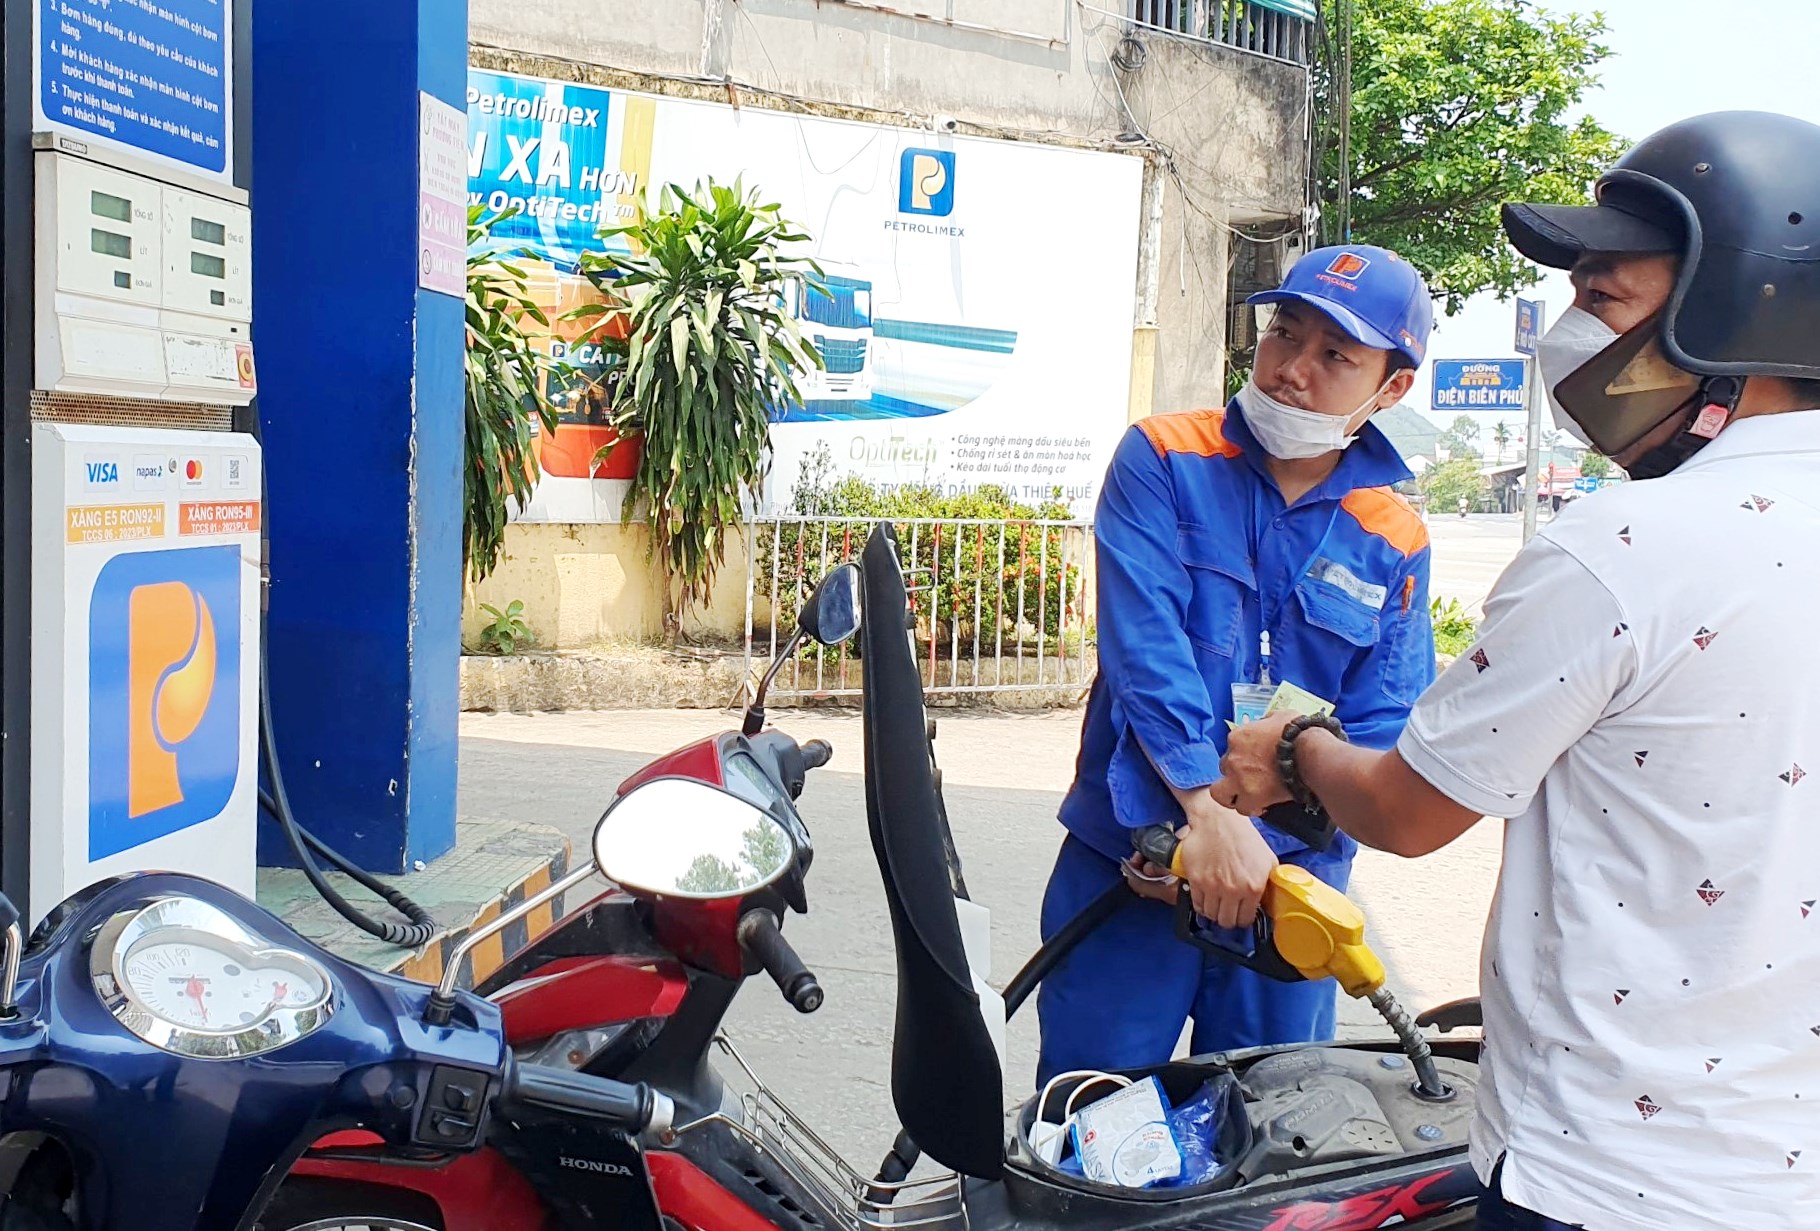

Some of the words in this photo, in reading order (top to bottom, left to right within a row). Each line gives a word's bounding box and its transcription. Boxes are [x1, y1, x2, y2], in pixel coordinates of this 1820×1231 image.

[61, 2, 81, 21] Bơm
[138, 35, 154, 52] theo
[50, 40, 58, 53] 4.
[79, 50, 103, 70] khách
[84, 69, 95, 84] khi
[97, 73, 116, 92] thanh
[51, 80, 58, 94] 5.
[101, 98, 122, 116] thanh
[498, 134, 571, 188] XA
[580, 166, 638, 196] HƠN
[488, 190, 606, 224] OptiTech
[884, 220, 965, 237] PETROLIMEX
[1462, 362, 1500, 374] ĐƯỜNG
[1438, 387, 1466, 406] ĐIỆN
[1468, 384, 1497, 405] BIÊN
[1500, 384, 1523, 404] PHỦ
[958, 434, 980, 446] Công
[983, 436, 1005, 447] nghệ
[1008, 437, 1033, 448] màng
[1054, 437, 1072, 447] siêu
[957, 448, 986, 460] Chống
[997, 450, 1012, 459] sét
[1014, 450, 1020, 459] &
[1076, 450, 1091, 462] học
[86, 463, 118, 483] VISA
[136, 467, 157, 480] napas
[956, 462, 974, 472] Kéo
[1014, 463, 1029, 474] thọ
[1066, 480, 1092, 498] HUẾ
[71, 508, 101, 528] XĂNG
[104, 510, 118, 526] E5
[119, 508, 161, 524] RON92-II
[187, 505, 214, 521] XĂNG
[81, 529, 103, 541] TCCS
[191, 523, 209, 533] TCCS
[559, 1156, 633, 1176] HONDA
